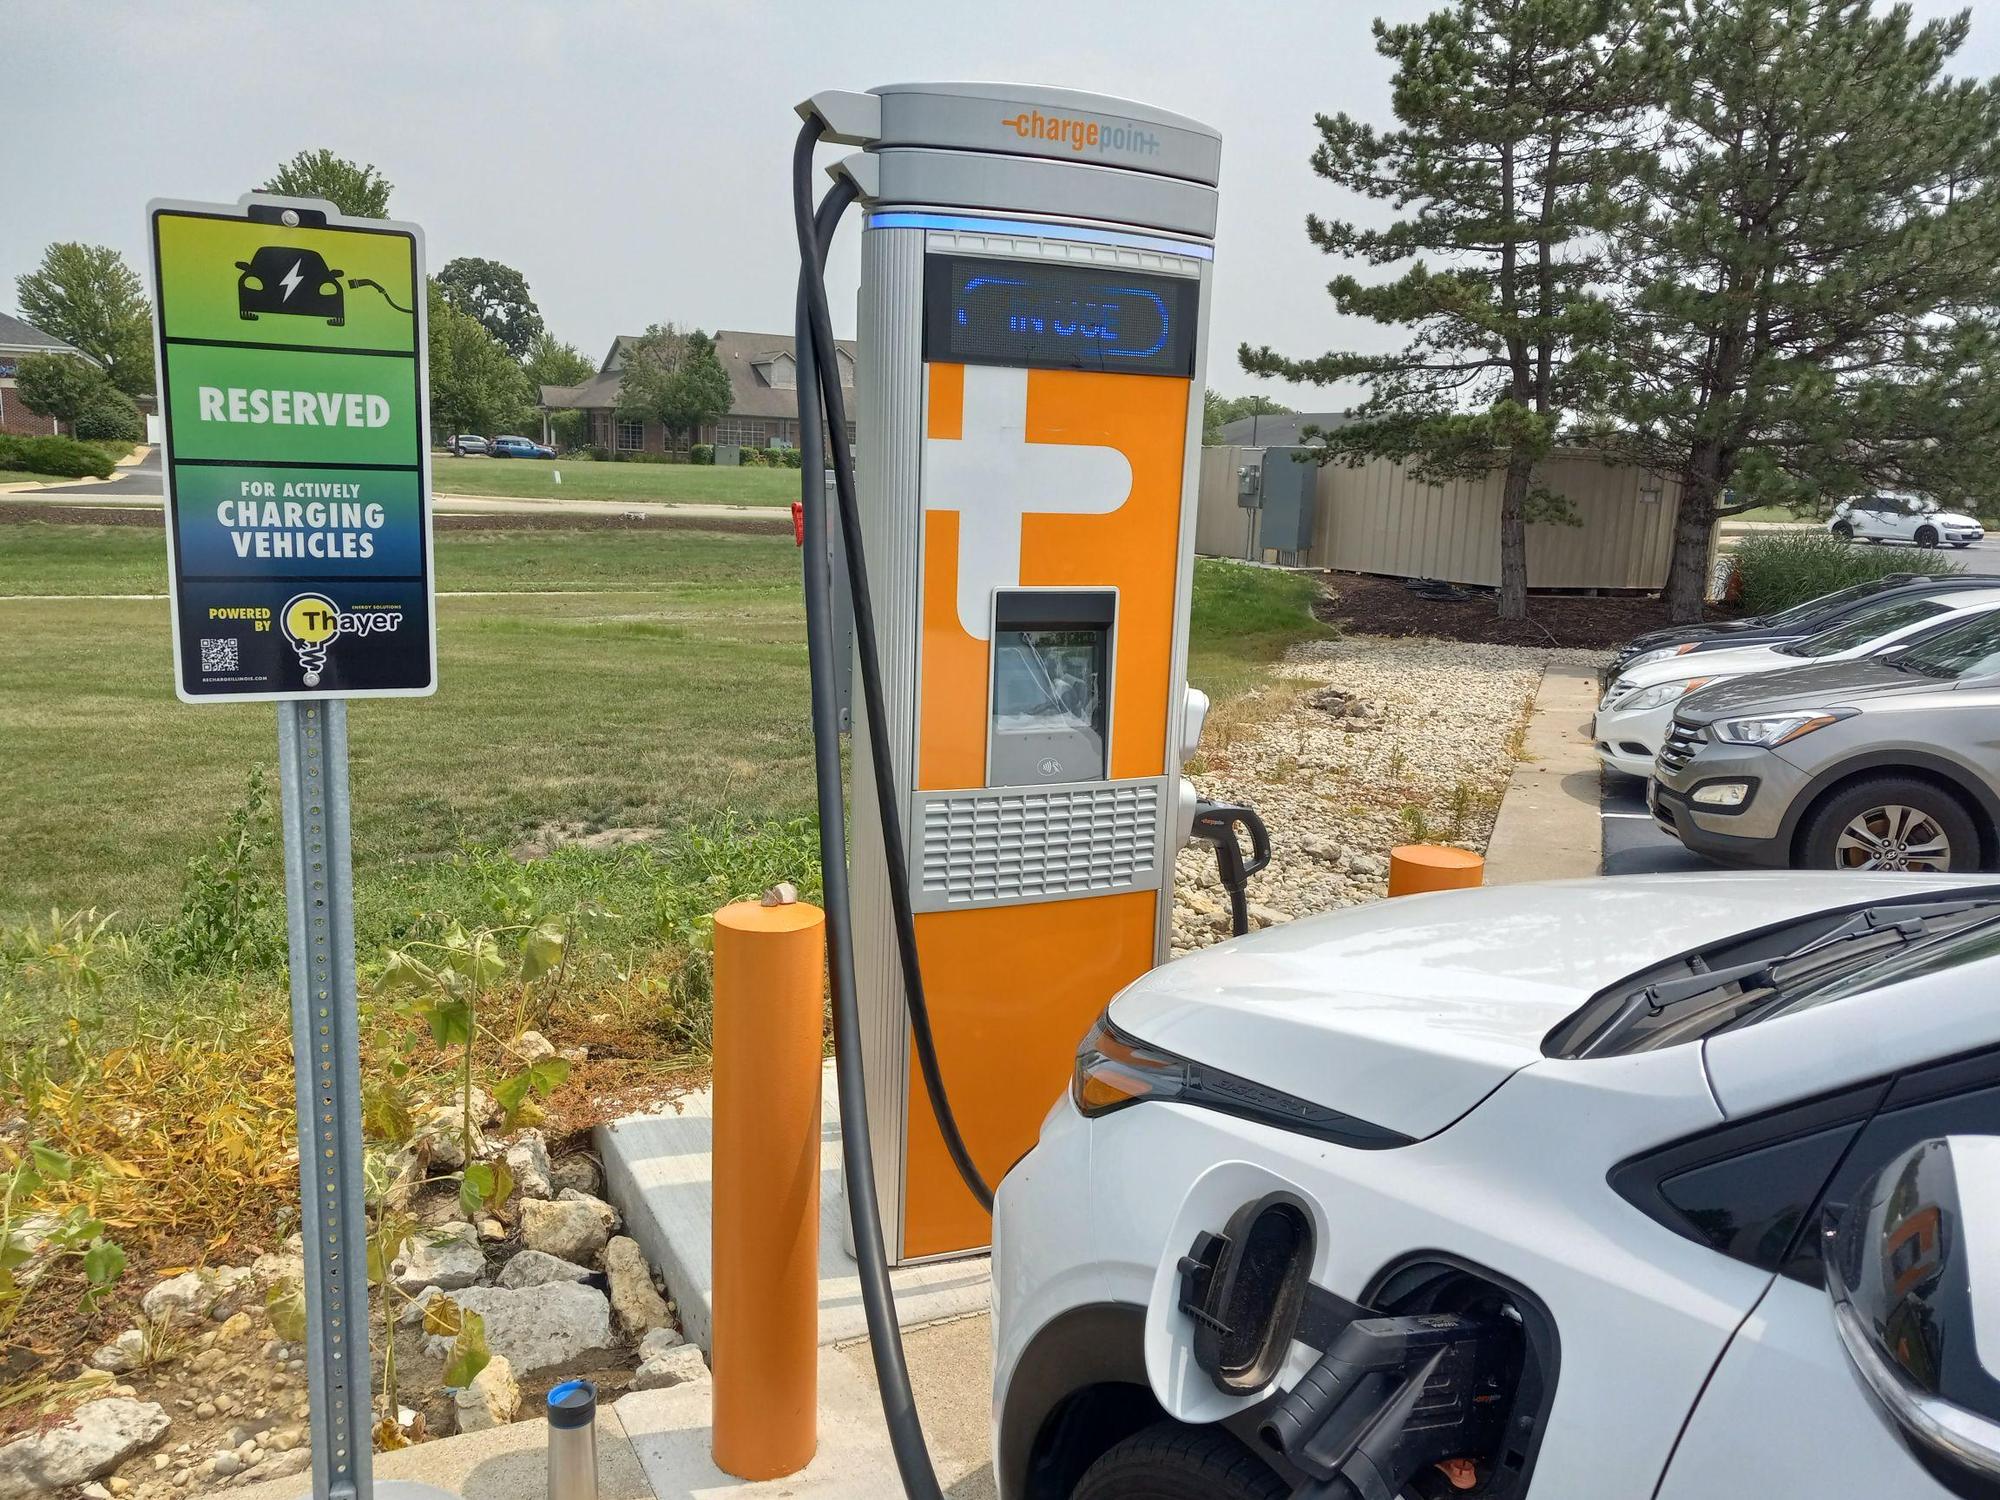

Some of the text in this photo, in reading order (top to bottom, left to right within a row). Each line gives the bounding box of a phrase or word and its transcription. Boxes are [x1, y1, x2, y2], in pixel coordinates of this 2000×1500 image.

[199, 386, 390, 428] RESERVED
[241, 481, 361, 498] FOR ACTIVELY
[216, 500, 385, 529] CHARGING
[231, 531, 374, 559] VEHICLES
[208, 607, 271, 620] POWERED
[254, 620, 272, 632] BY
[302, 609, 403, 637] Thayer
